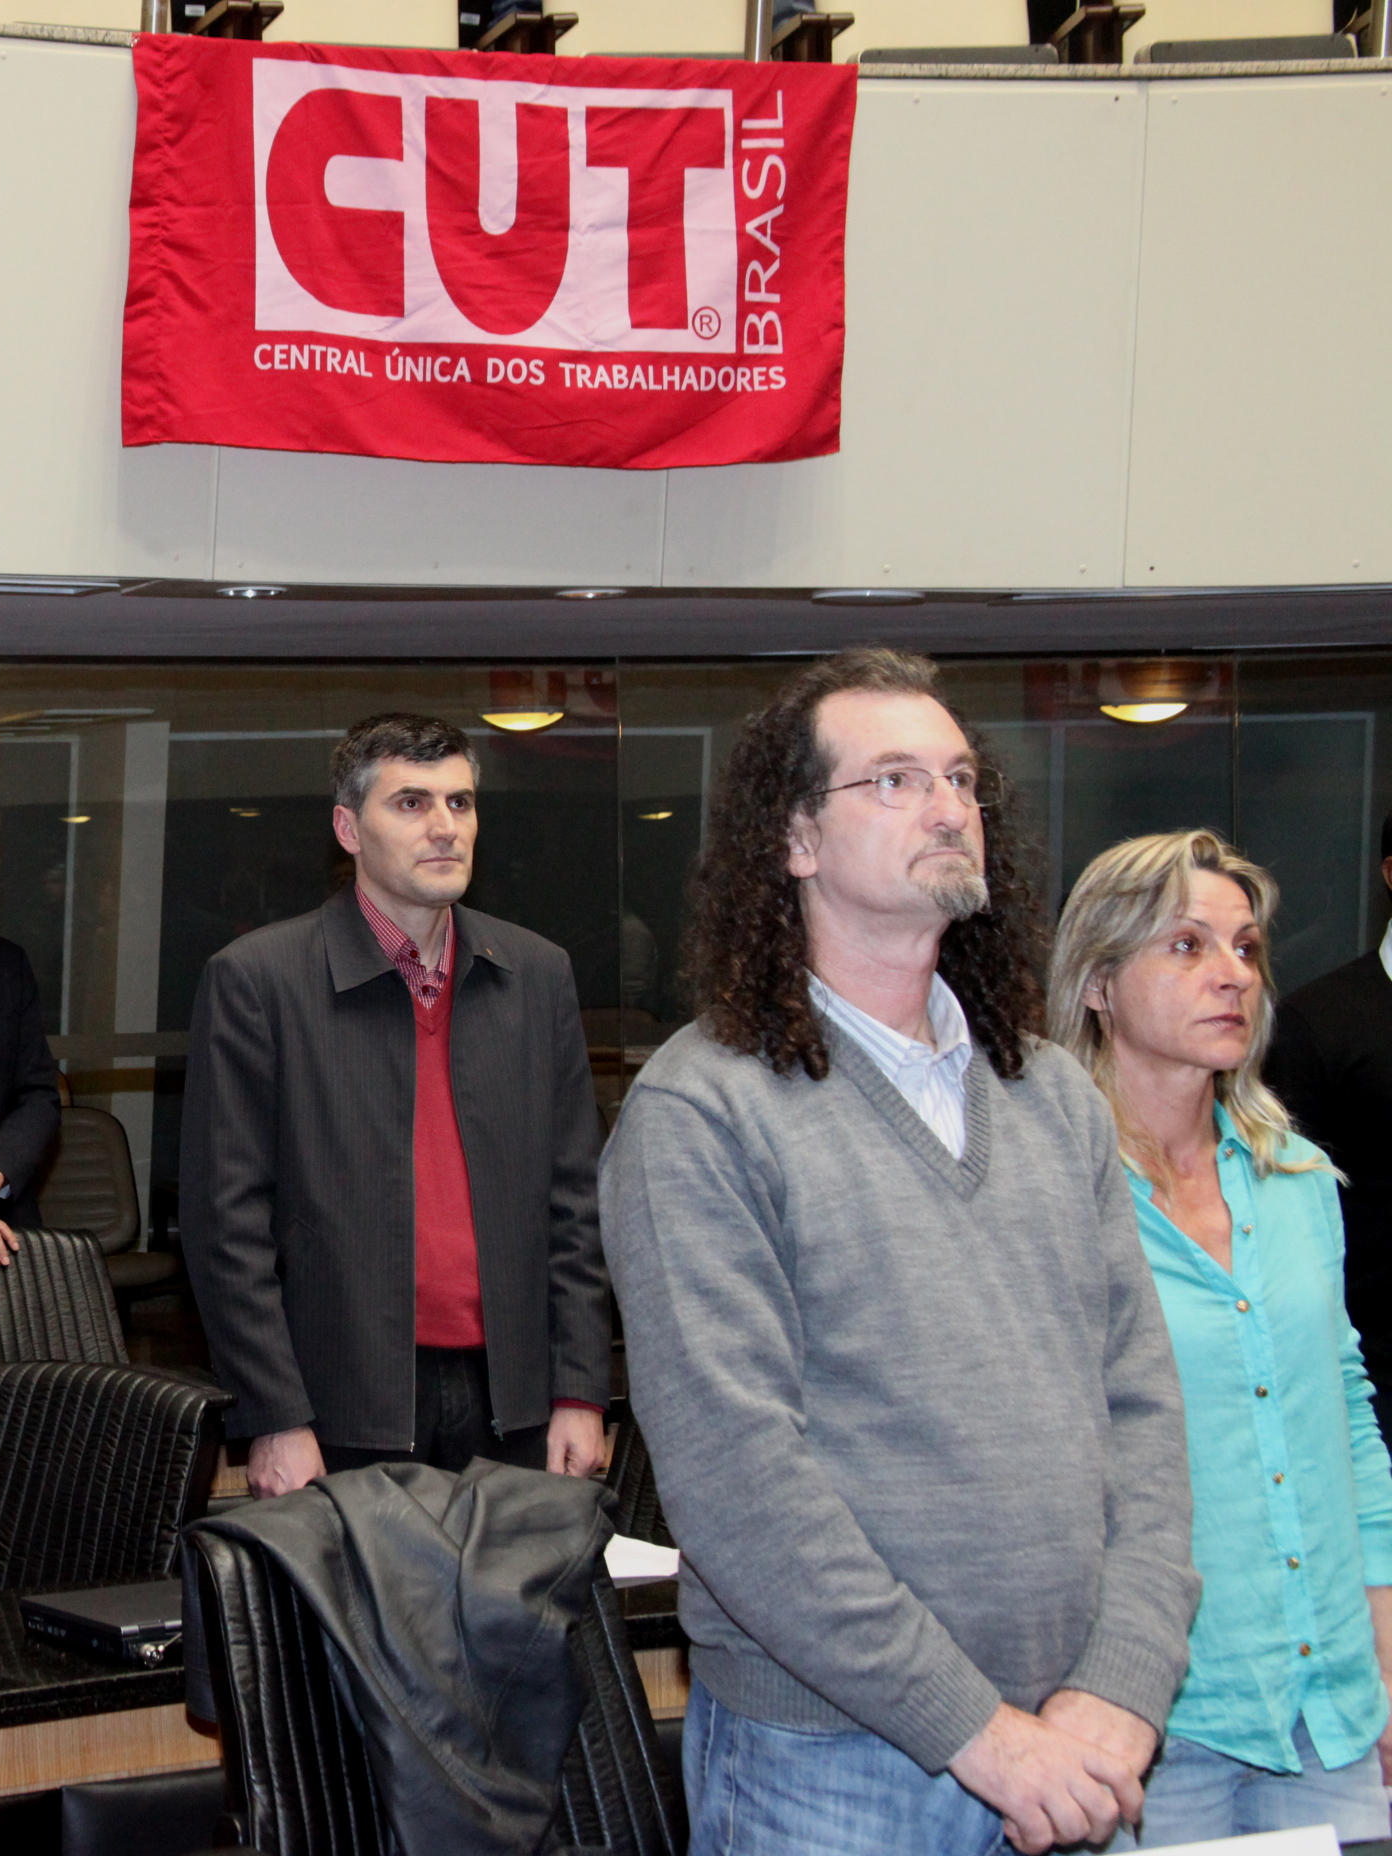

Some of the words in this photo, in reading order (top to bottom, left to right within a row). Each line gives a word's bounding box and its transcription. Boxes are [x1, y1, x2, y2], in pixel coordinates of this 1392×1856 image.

[265, 87, 725, 336] CUT
[740, 89, 787, 355] BRASIL
[253, 343, 373, 378] CENTRAL
[384, 346, 472, 383] ÚNICA
[486, 357, 546, 386] DOS
[558, 361, 787, 393] TRABALHADORES
